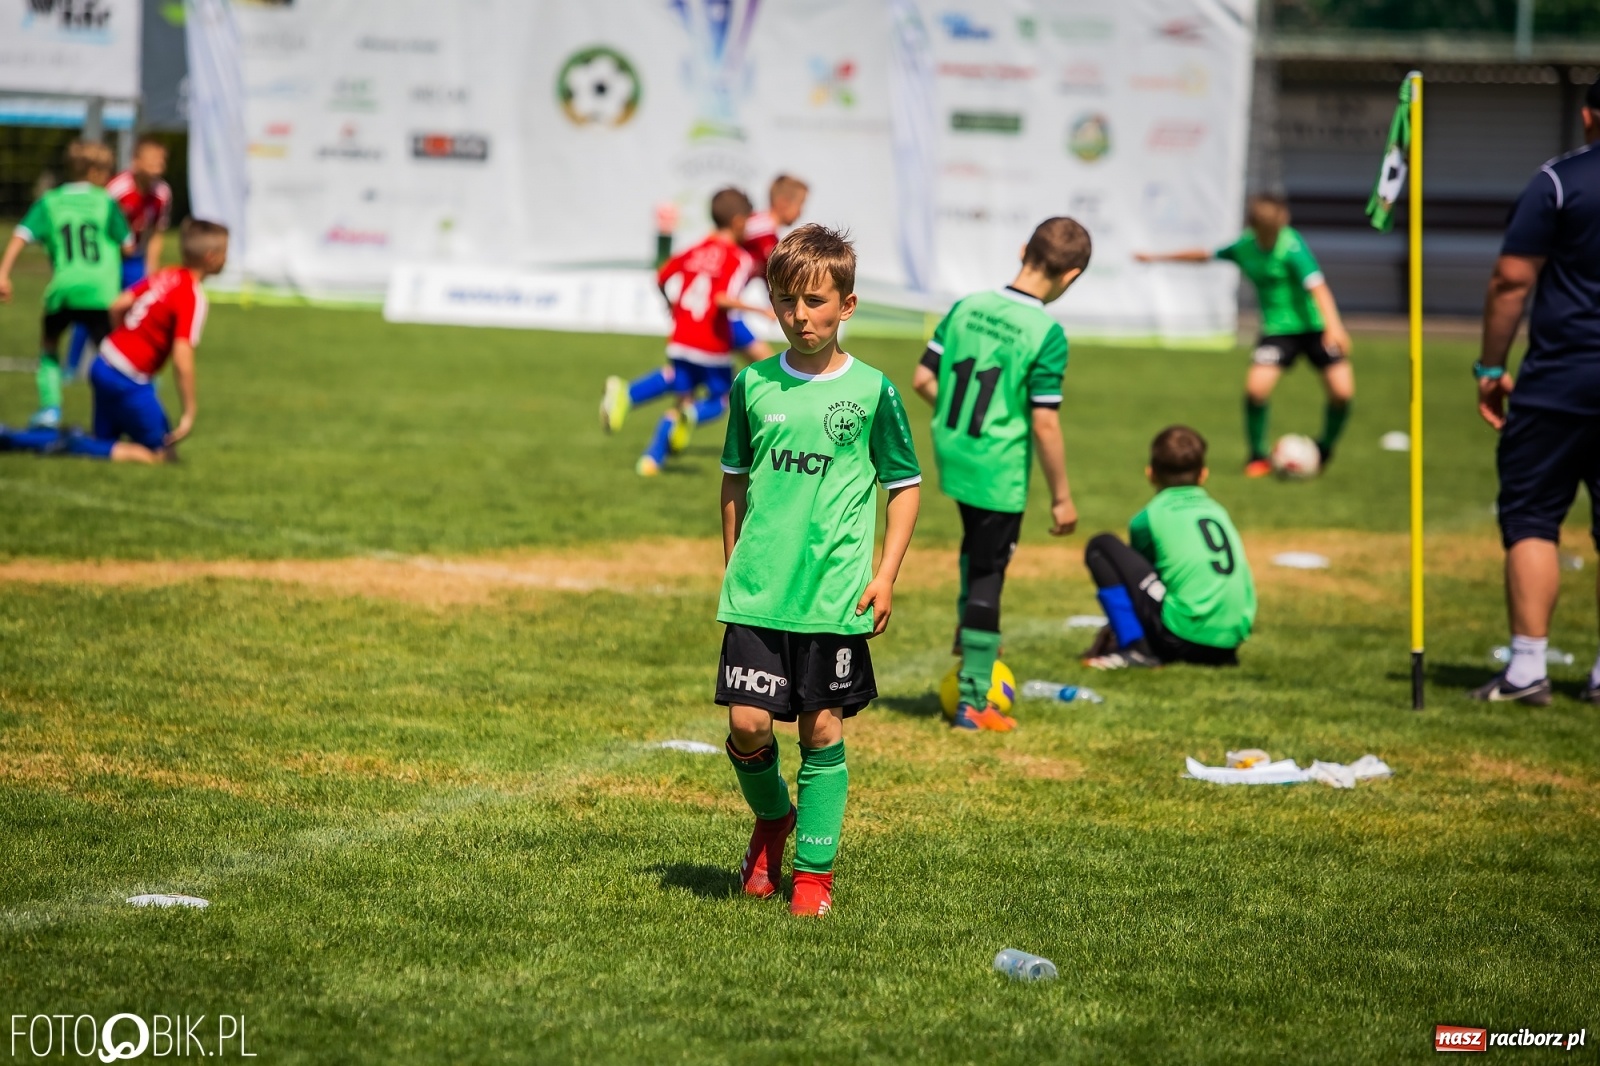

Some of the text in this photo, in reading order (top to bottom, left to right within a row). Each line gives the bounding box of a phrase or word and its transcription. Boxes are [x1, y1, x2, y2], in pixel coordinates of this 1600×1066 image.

[60, 222, 101, 264] 16
[827, 400, 868, 422] HATTRICK
[945, 356, 1002, 439] 11
[763, 413, 787, 423] JAKO
[1198, 518, 1234, 575] 9
[835, 647, 853, 679] 8
[799, 834, 833, 846] JAKO
